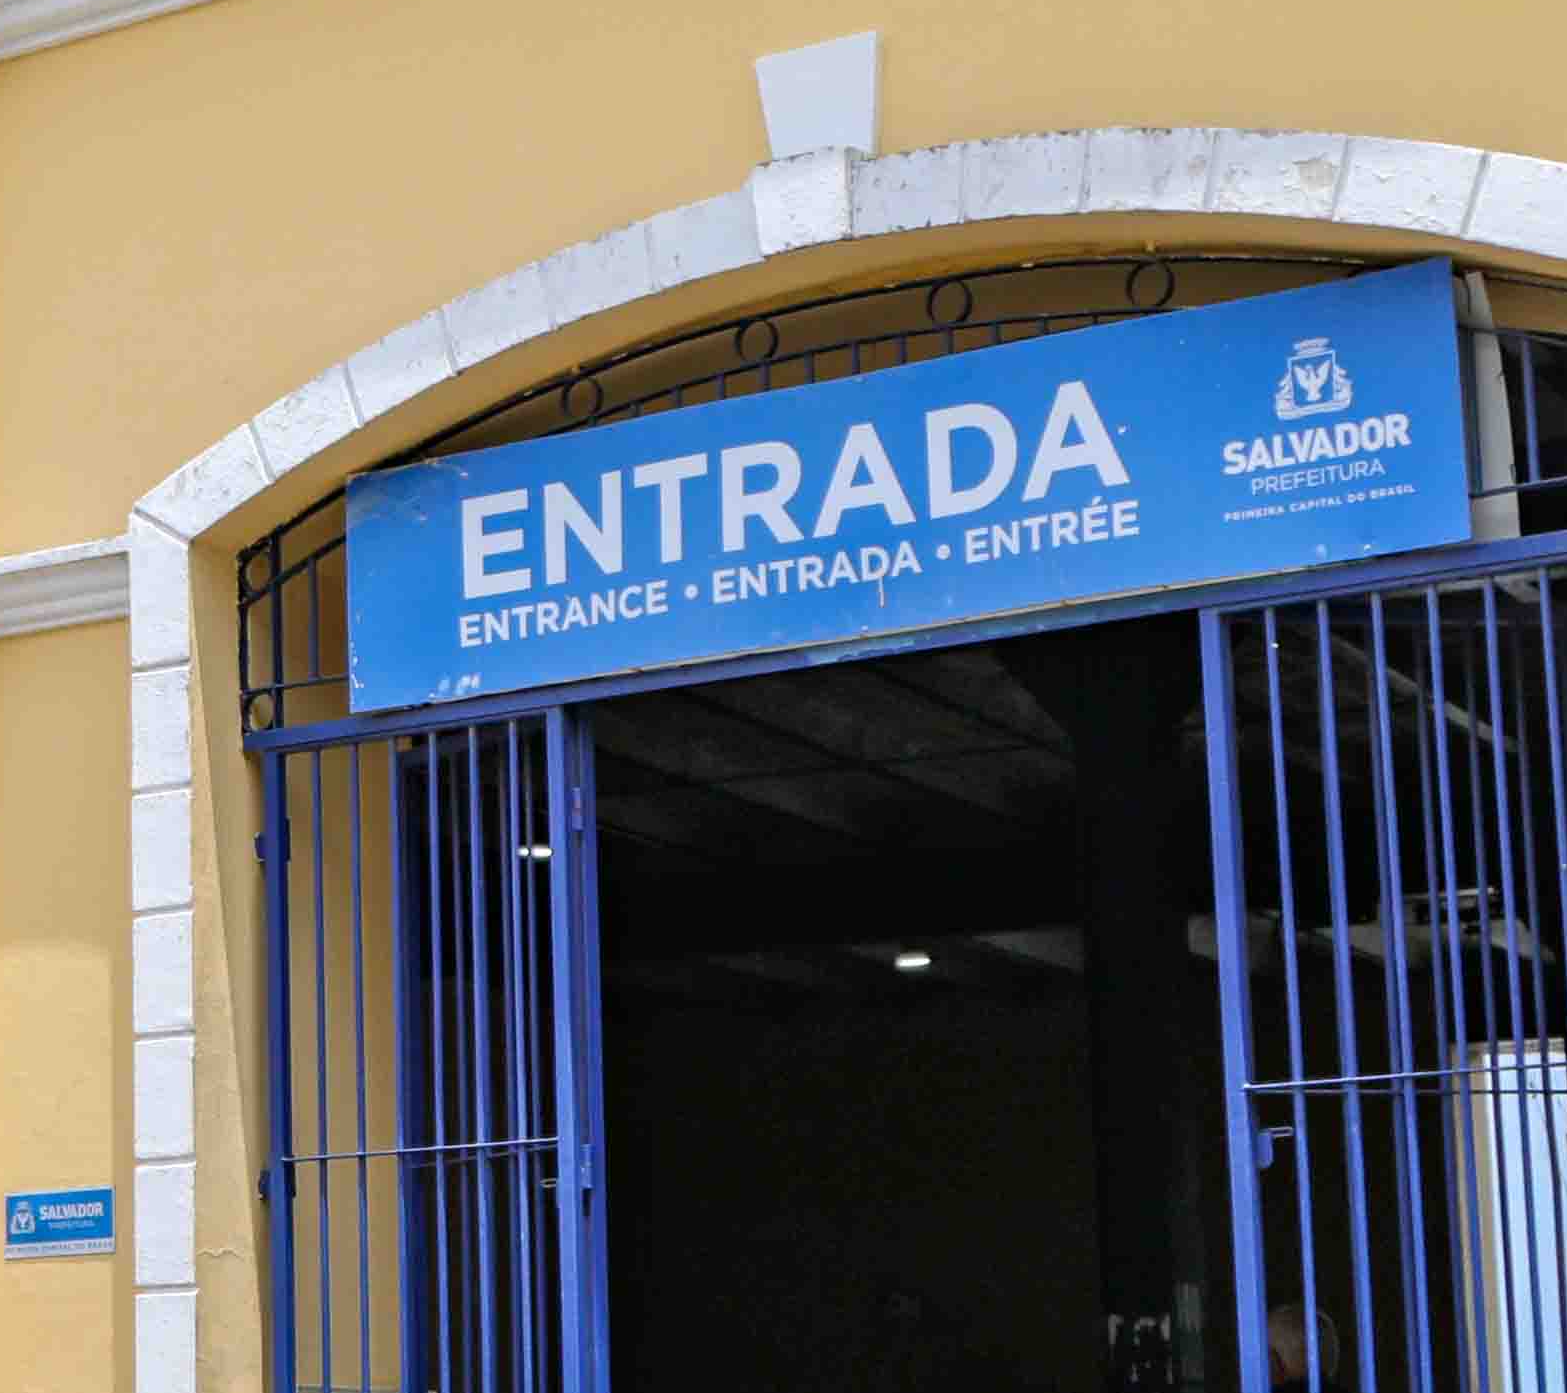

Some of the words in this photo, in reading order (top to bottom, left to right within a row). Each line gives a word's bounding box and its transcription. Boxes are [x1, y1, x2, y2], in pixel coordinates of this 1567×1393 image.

[460, 380, 1131, 600] ENTRADA
[1222, 412, 1412, 475] SALVADOR
[1251, 458, 1387, 496] PREFEITURA
[459, 579, 668, 648] ENTRANCE
[712, 540, 922, 604] ENTRADA
[964, 496, 1140, 564] ENTRÉE
